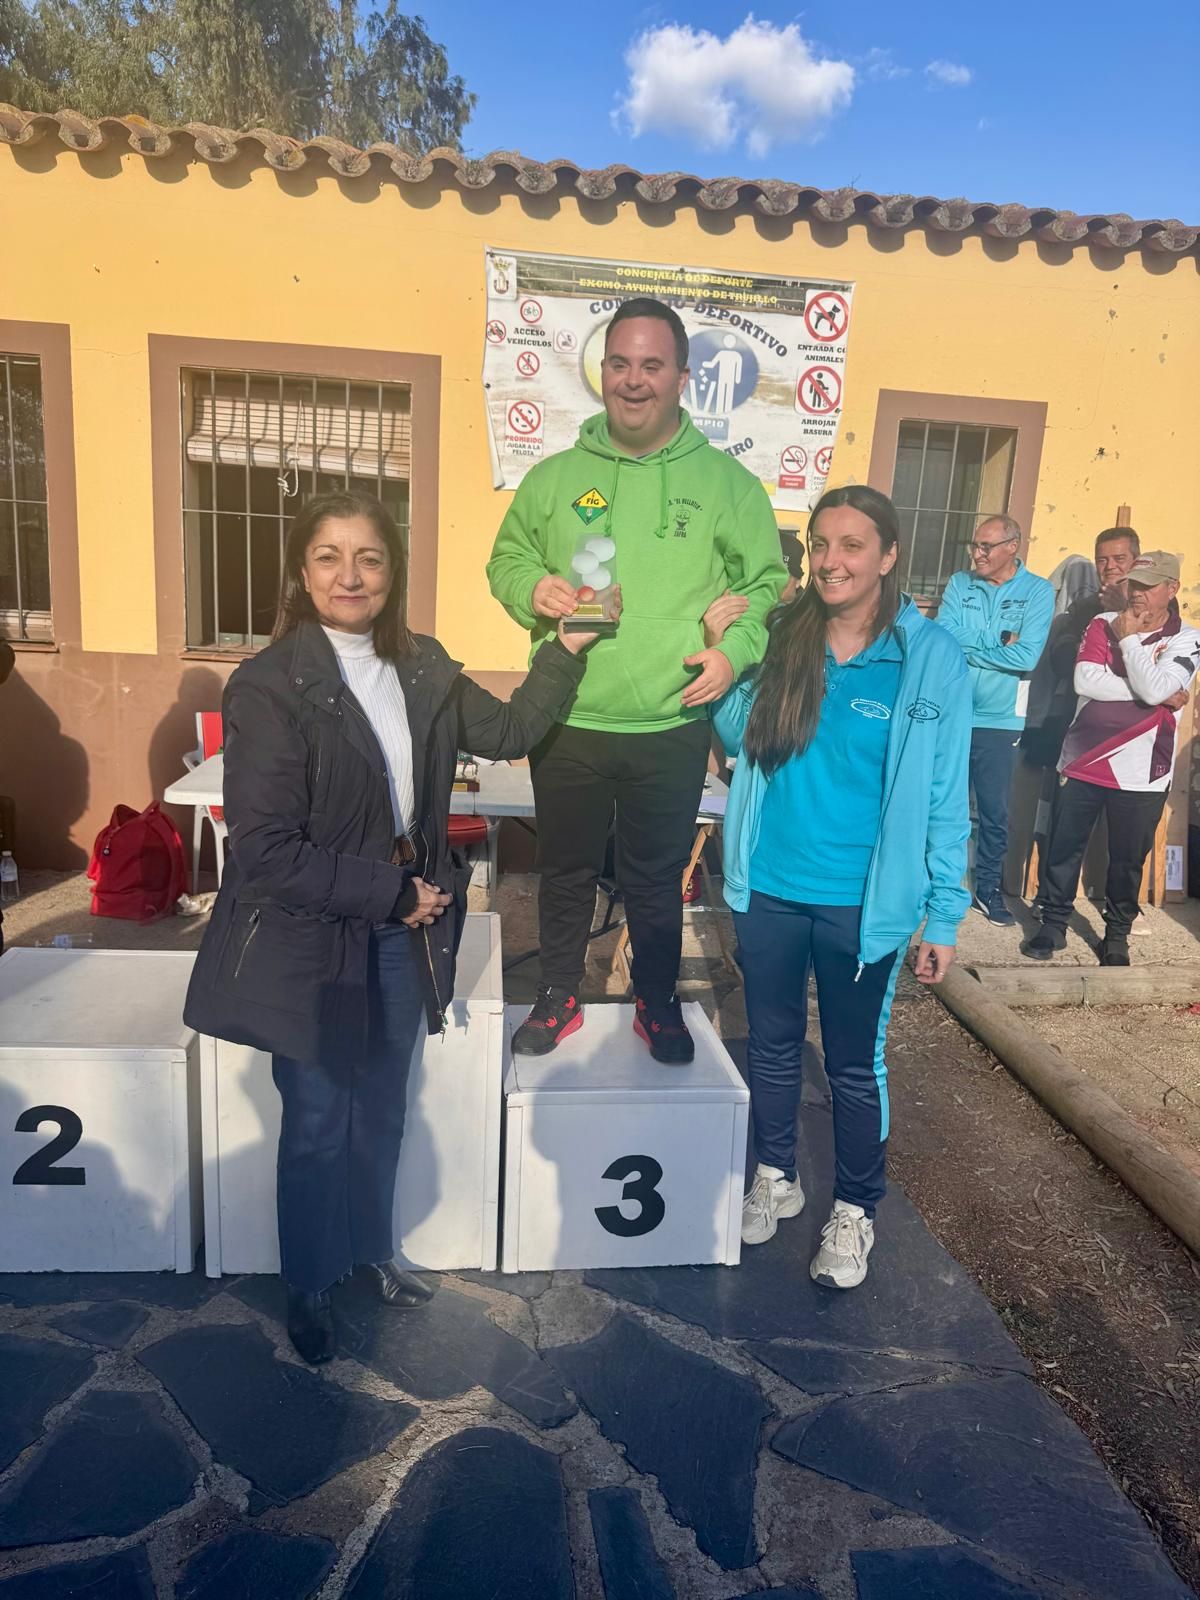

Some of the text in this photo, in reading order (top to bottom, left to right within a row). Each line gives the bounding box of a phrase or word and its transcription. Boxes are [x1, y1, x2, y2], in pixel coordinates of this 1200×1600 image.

[702, 275, 753, 288] DEPORTE
[625, 282, 710, 298] AYUNTAMIENTO
[712, 289, 727, 300] DE
[729, 292, 777, 304] TRUJILLO
[513, 327, 546, 337] ACCESO
[694, 303, 787, 356] DEPORTIVO
[507, 337, 552, 348] VEHÍCULOS
[797, 343, 834, 353] ENTRADA
[804, 354, 844, 363] ANIMALES
[801, 418, 837, 427] ARROJAR
[803, 428, 833, 436] BASURA
[504, 435, 543, 444] PROHIBIDO
[586, 497, 599, 505] FIG
[12, 1105, 86, 1185] 2
[594, 1155, 666, 1237] 3
